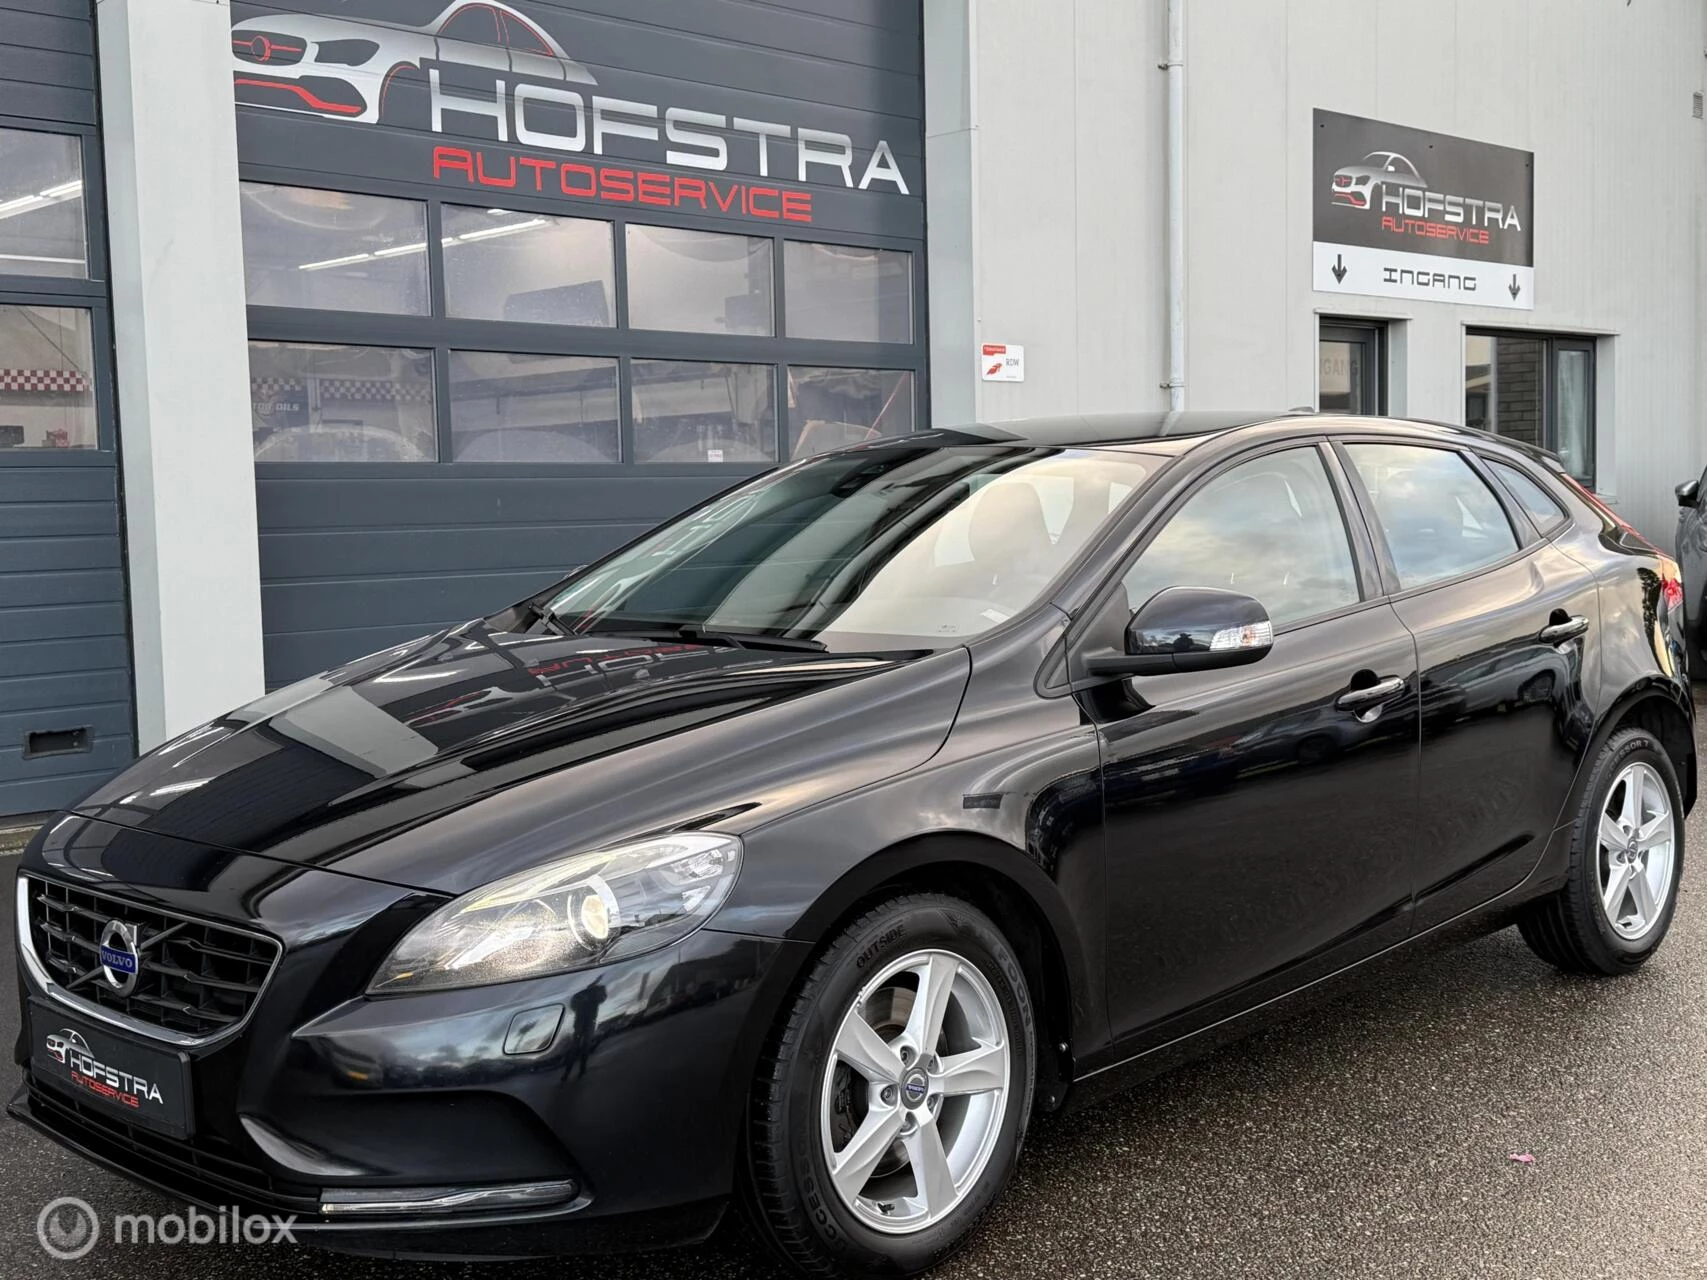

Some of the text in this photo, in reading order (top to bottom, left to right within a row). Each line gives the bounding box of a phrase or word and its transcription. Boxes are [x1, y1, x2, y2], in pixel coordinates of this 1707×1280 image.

[428, 68, 910, 195] HOFSTRA
[433, 146, 812, 222] AUTOSERVICE
[1381, 184, 1522, 232] HOFSTRA
[1381, 216, 1490, 245] AUTOSERVICE
[1383, 267, 1477, 291] INGANG
[1320, 358, 1359, 377] GANG
[101, 949, 134, 968] VOLVO
[857, 923, 905, 968] OUTSIDE
[69, 1050, 164, 1104] HOFSTRA
[71, 1071, 140, 1108] AUTOSERVICE
